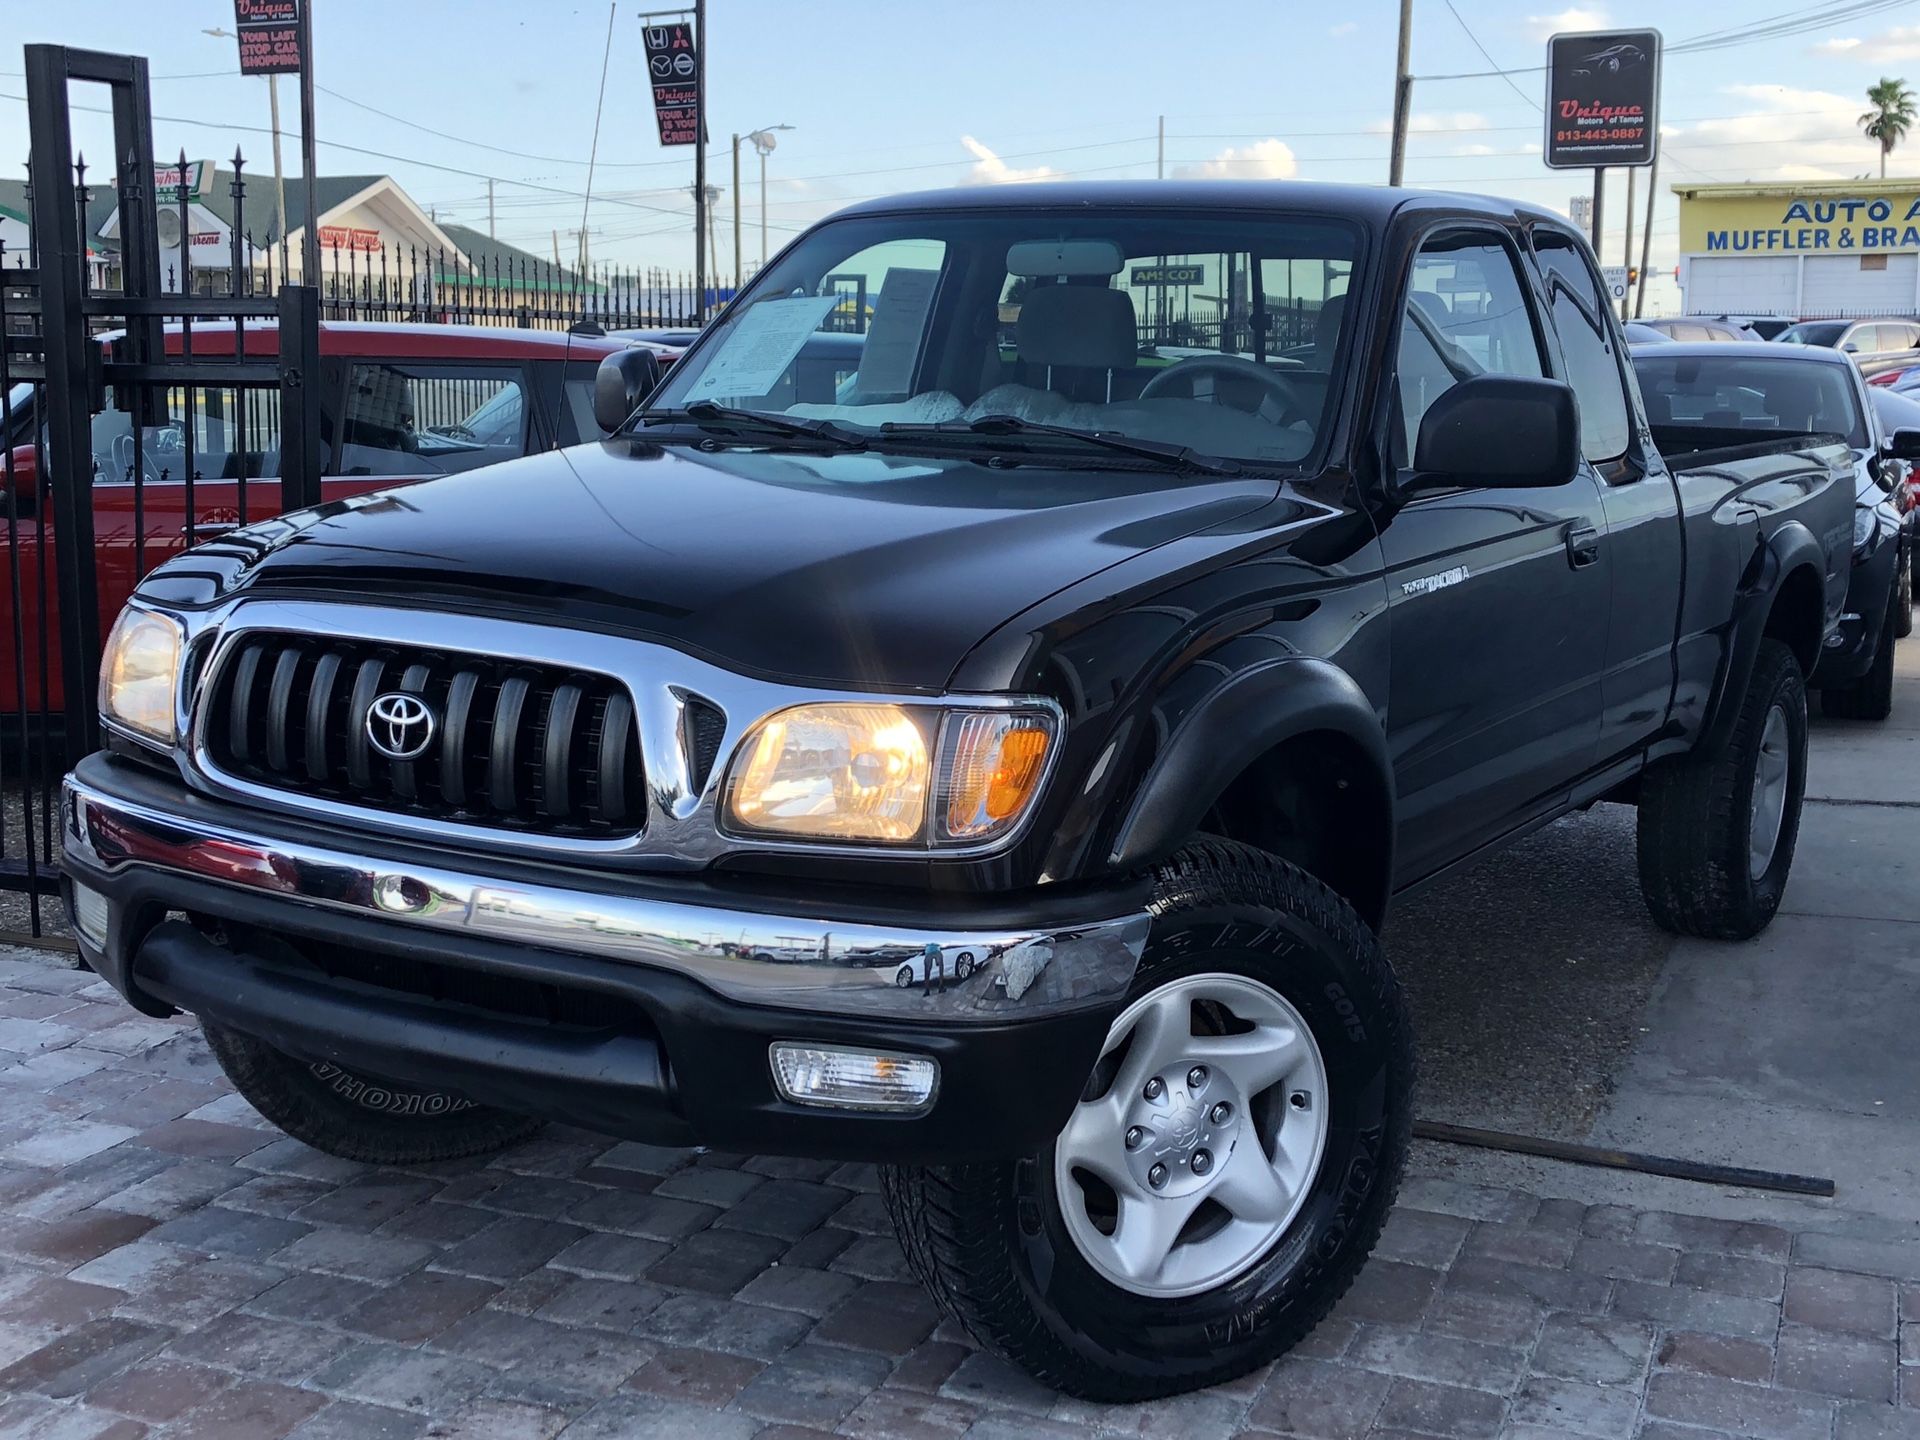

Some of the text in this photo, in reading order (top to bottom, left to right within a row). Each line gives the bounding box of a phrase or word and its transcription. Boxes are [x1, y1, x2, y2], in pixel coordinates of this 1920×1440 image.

[241, 30, 296, 42] YOUR LAST
[241, 42, 298, 56] STOP CAR
[242, 53, 300, 67] SHOPPING
[658, 110, 683, 120] YOUR
[1559, 99, 1644, 120] Unique
[663, 120, 673, 129] IS
[1577, 117, 1604, 125] Motors
[1619, 115, 1644, 124] Tampa
[661, 130, 695, 143] CRED
[1781, 199, 1893, 224] AUTO
[1707, 226, 1920, 250] MUFFLER & BRA
[1135, 269, 1197, 281] AMSCOT
